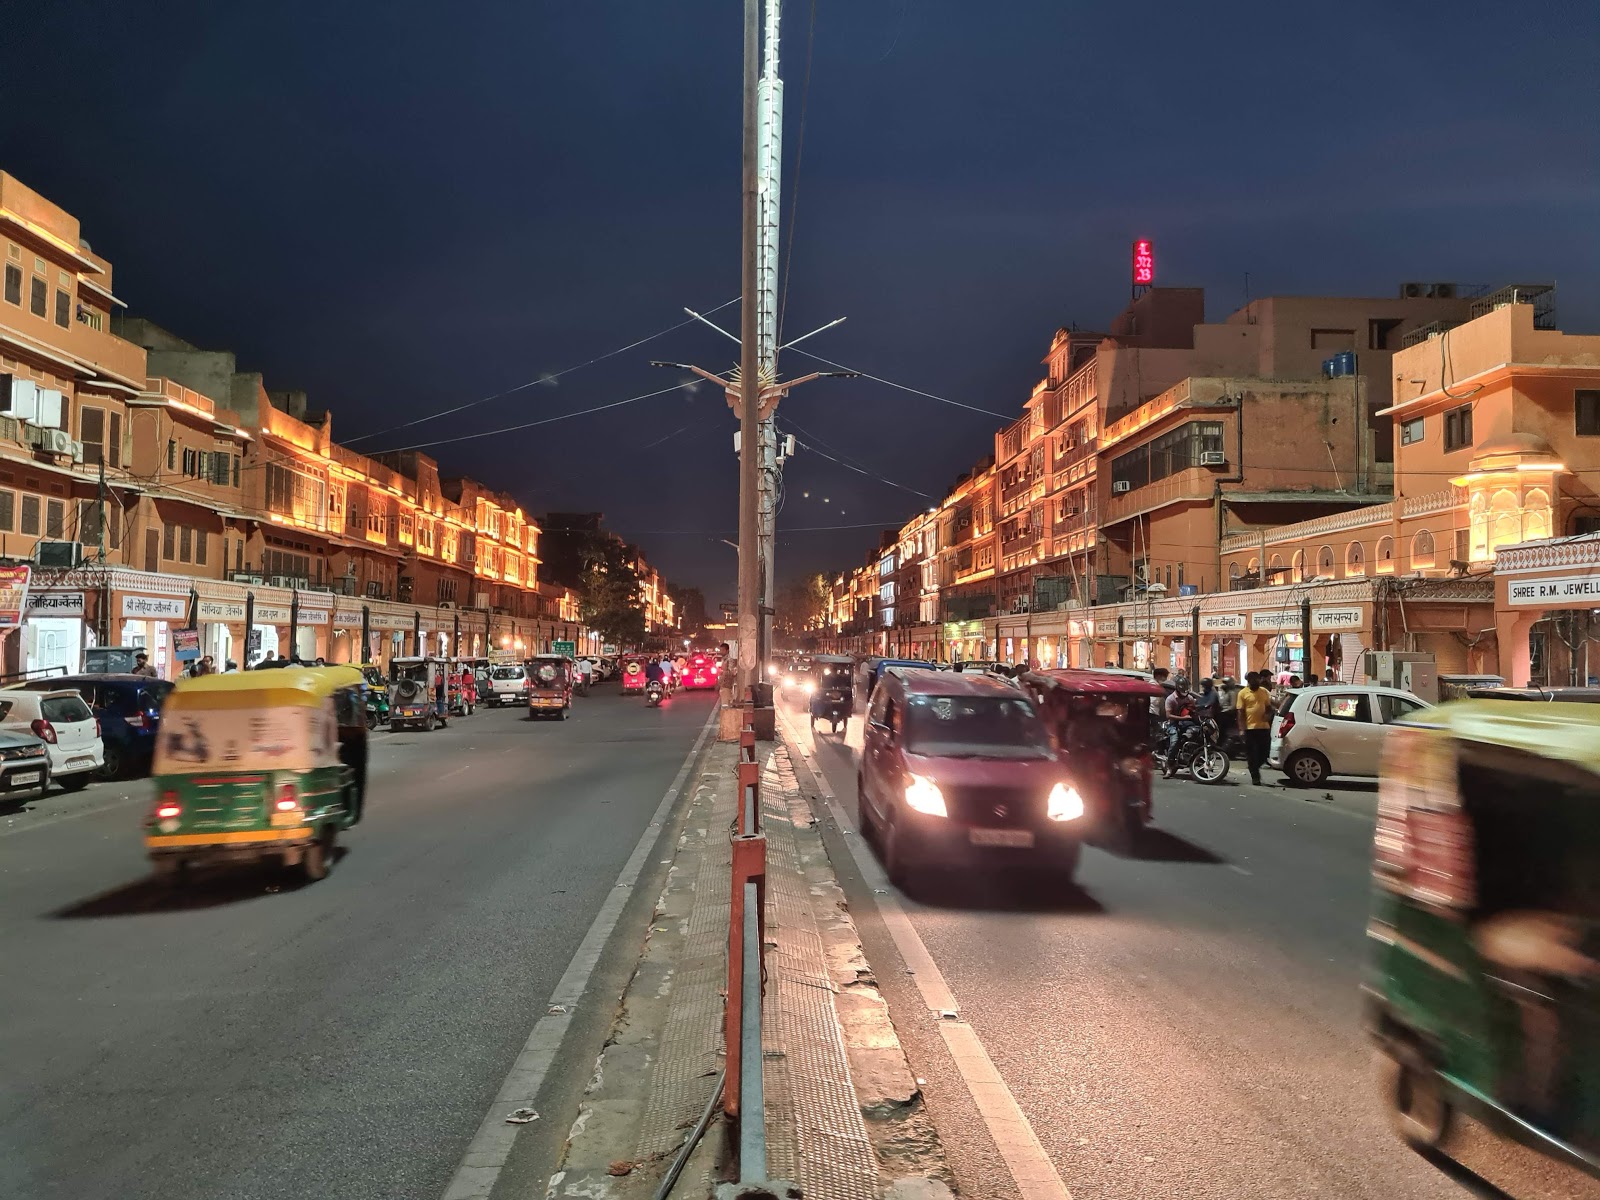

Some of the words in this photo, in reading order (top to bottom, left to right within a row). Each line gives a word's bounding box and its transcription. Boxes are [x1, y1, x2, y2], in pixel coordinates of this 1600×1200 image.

[1136, 242, 1152, 281] LMB
[1513, 586, 1535, 598] SHREE
[1540, 585, 1560, 597] R.M.
[1563, 581, 1600, 595] JEWELL
[126, 598, 134, 611] श्री
